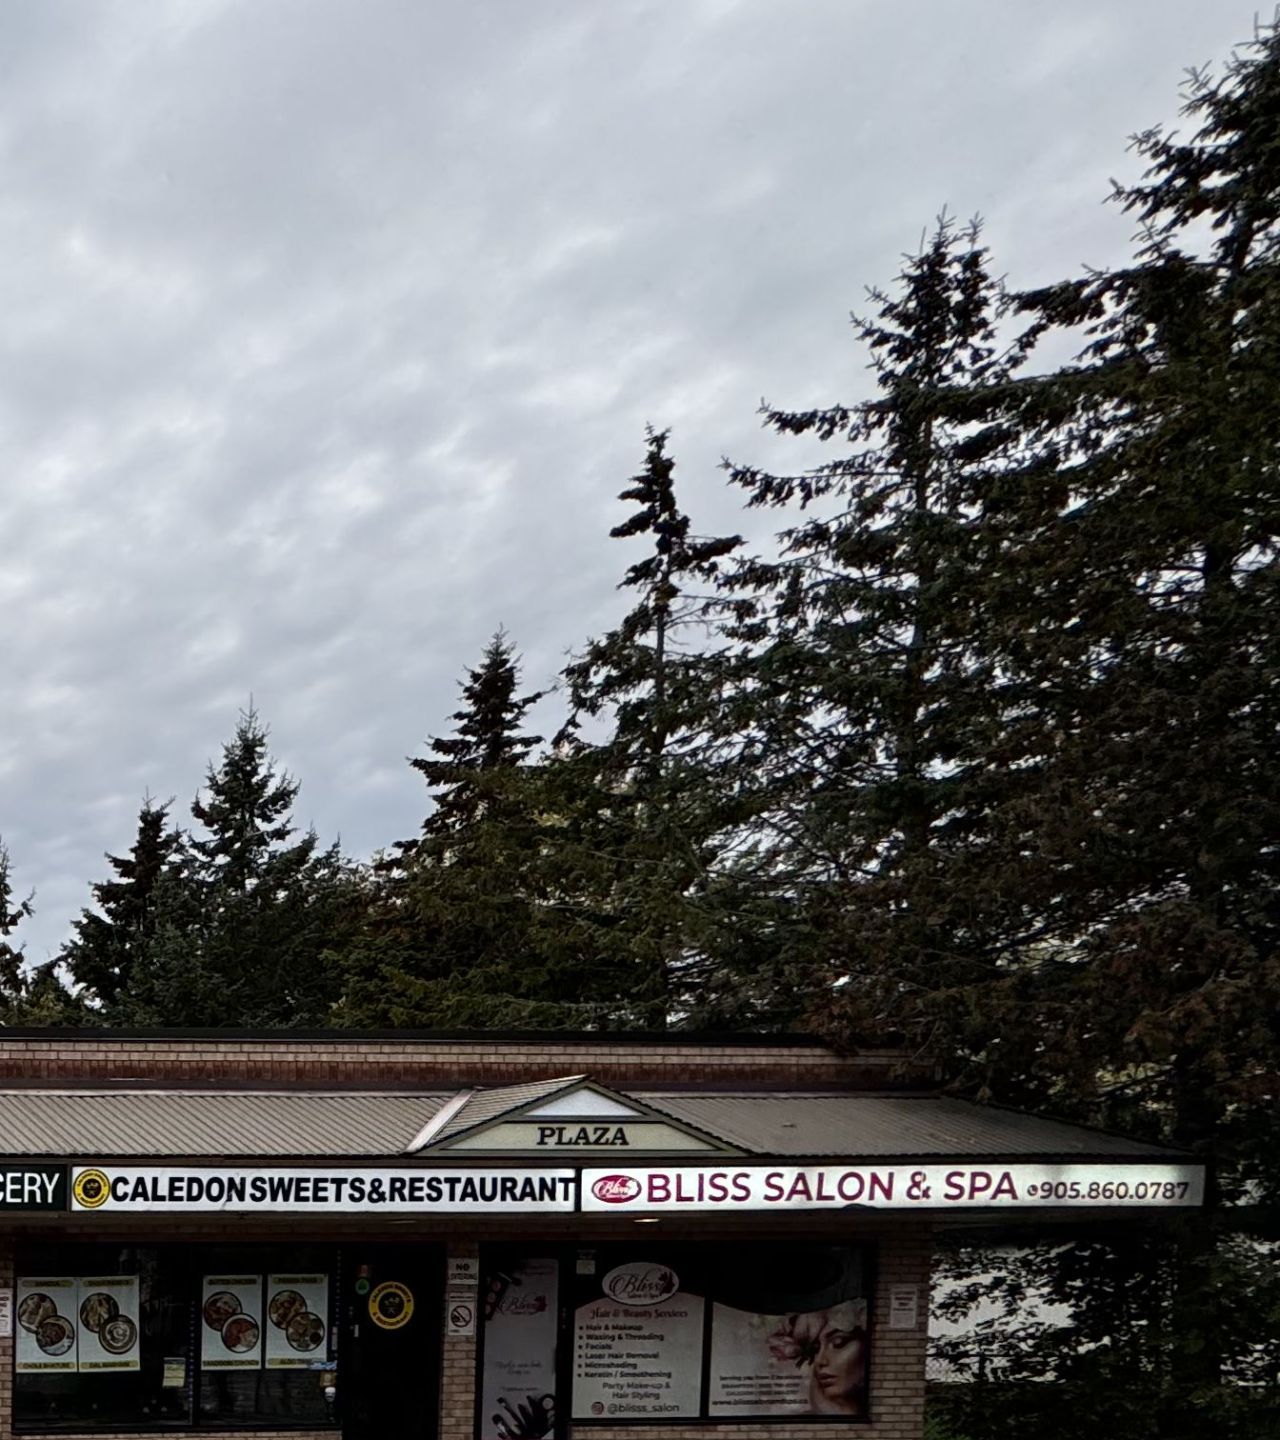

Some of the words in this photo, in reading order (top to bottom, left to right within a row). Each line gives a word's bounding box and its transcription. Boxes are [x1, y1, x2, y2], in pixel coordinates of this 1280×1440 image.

[536, 1127, 629, 1146] PLAZA
[647, 1173, 752, 1202] BLISS
[763, 1171, 895, 1201] SALON
[906, 1171, 932, 1200] &
[943, 1171, 1019, 1200] SPA
[1039, 1181, 1190, 1200] 905.860.0787
[455, 1263, 470, 1271] NO
[622, 1309, 652, 1319] Beauty
[586, 1334, 616, 1342] Waxing
[602, 1382, 623, 1391] Party
